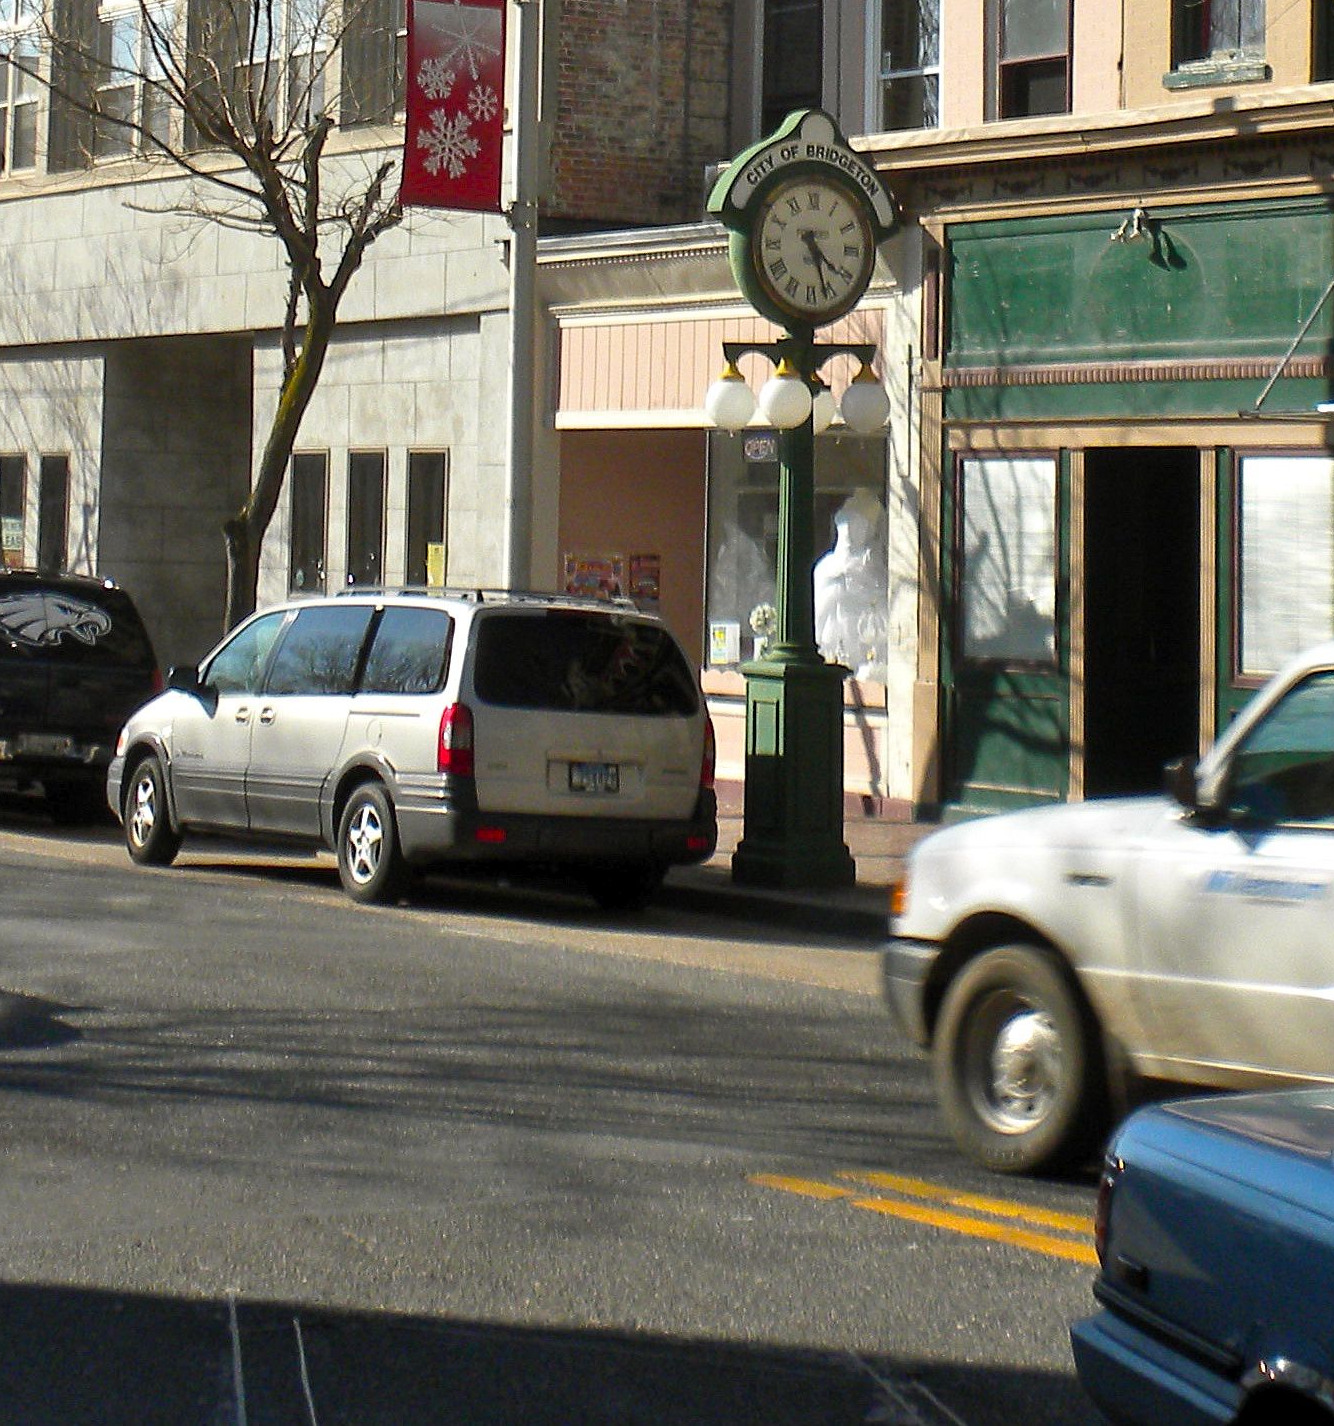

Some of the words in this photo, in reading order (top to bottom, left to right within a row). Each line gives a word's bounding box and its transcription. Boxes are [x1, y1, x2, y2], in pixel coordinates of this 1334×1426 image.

[747, 156, 775, 185] CITY
[780, 145, 799, 162] OF
[805, 144, 881, 197] BRIDGETON
